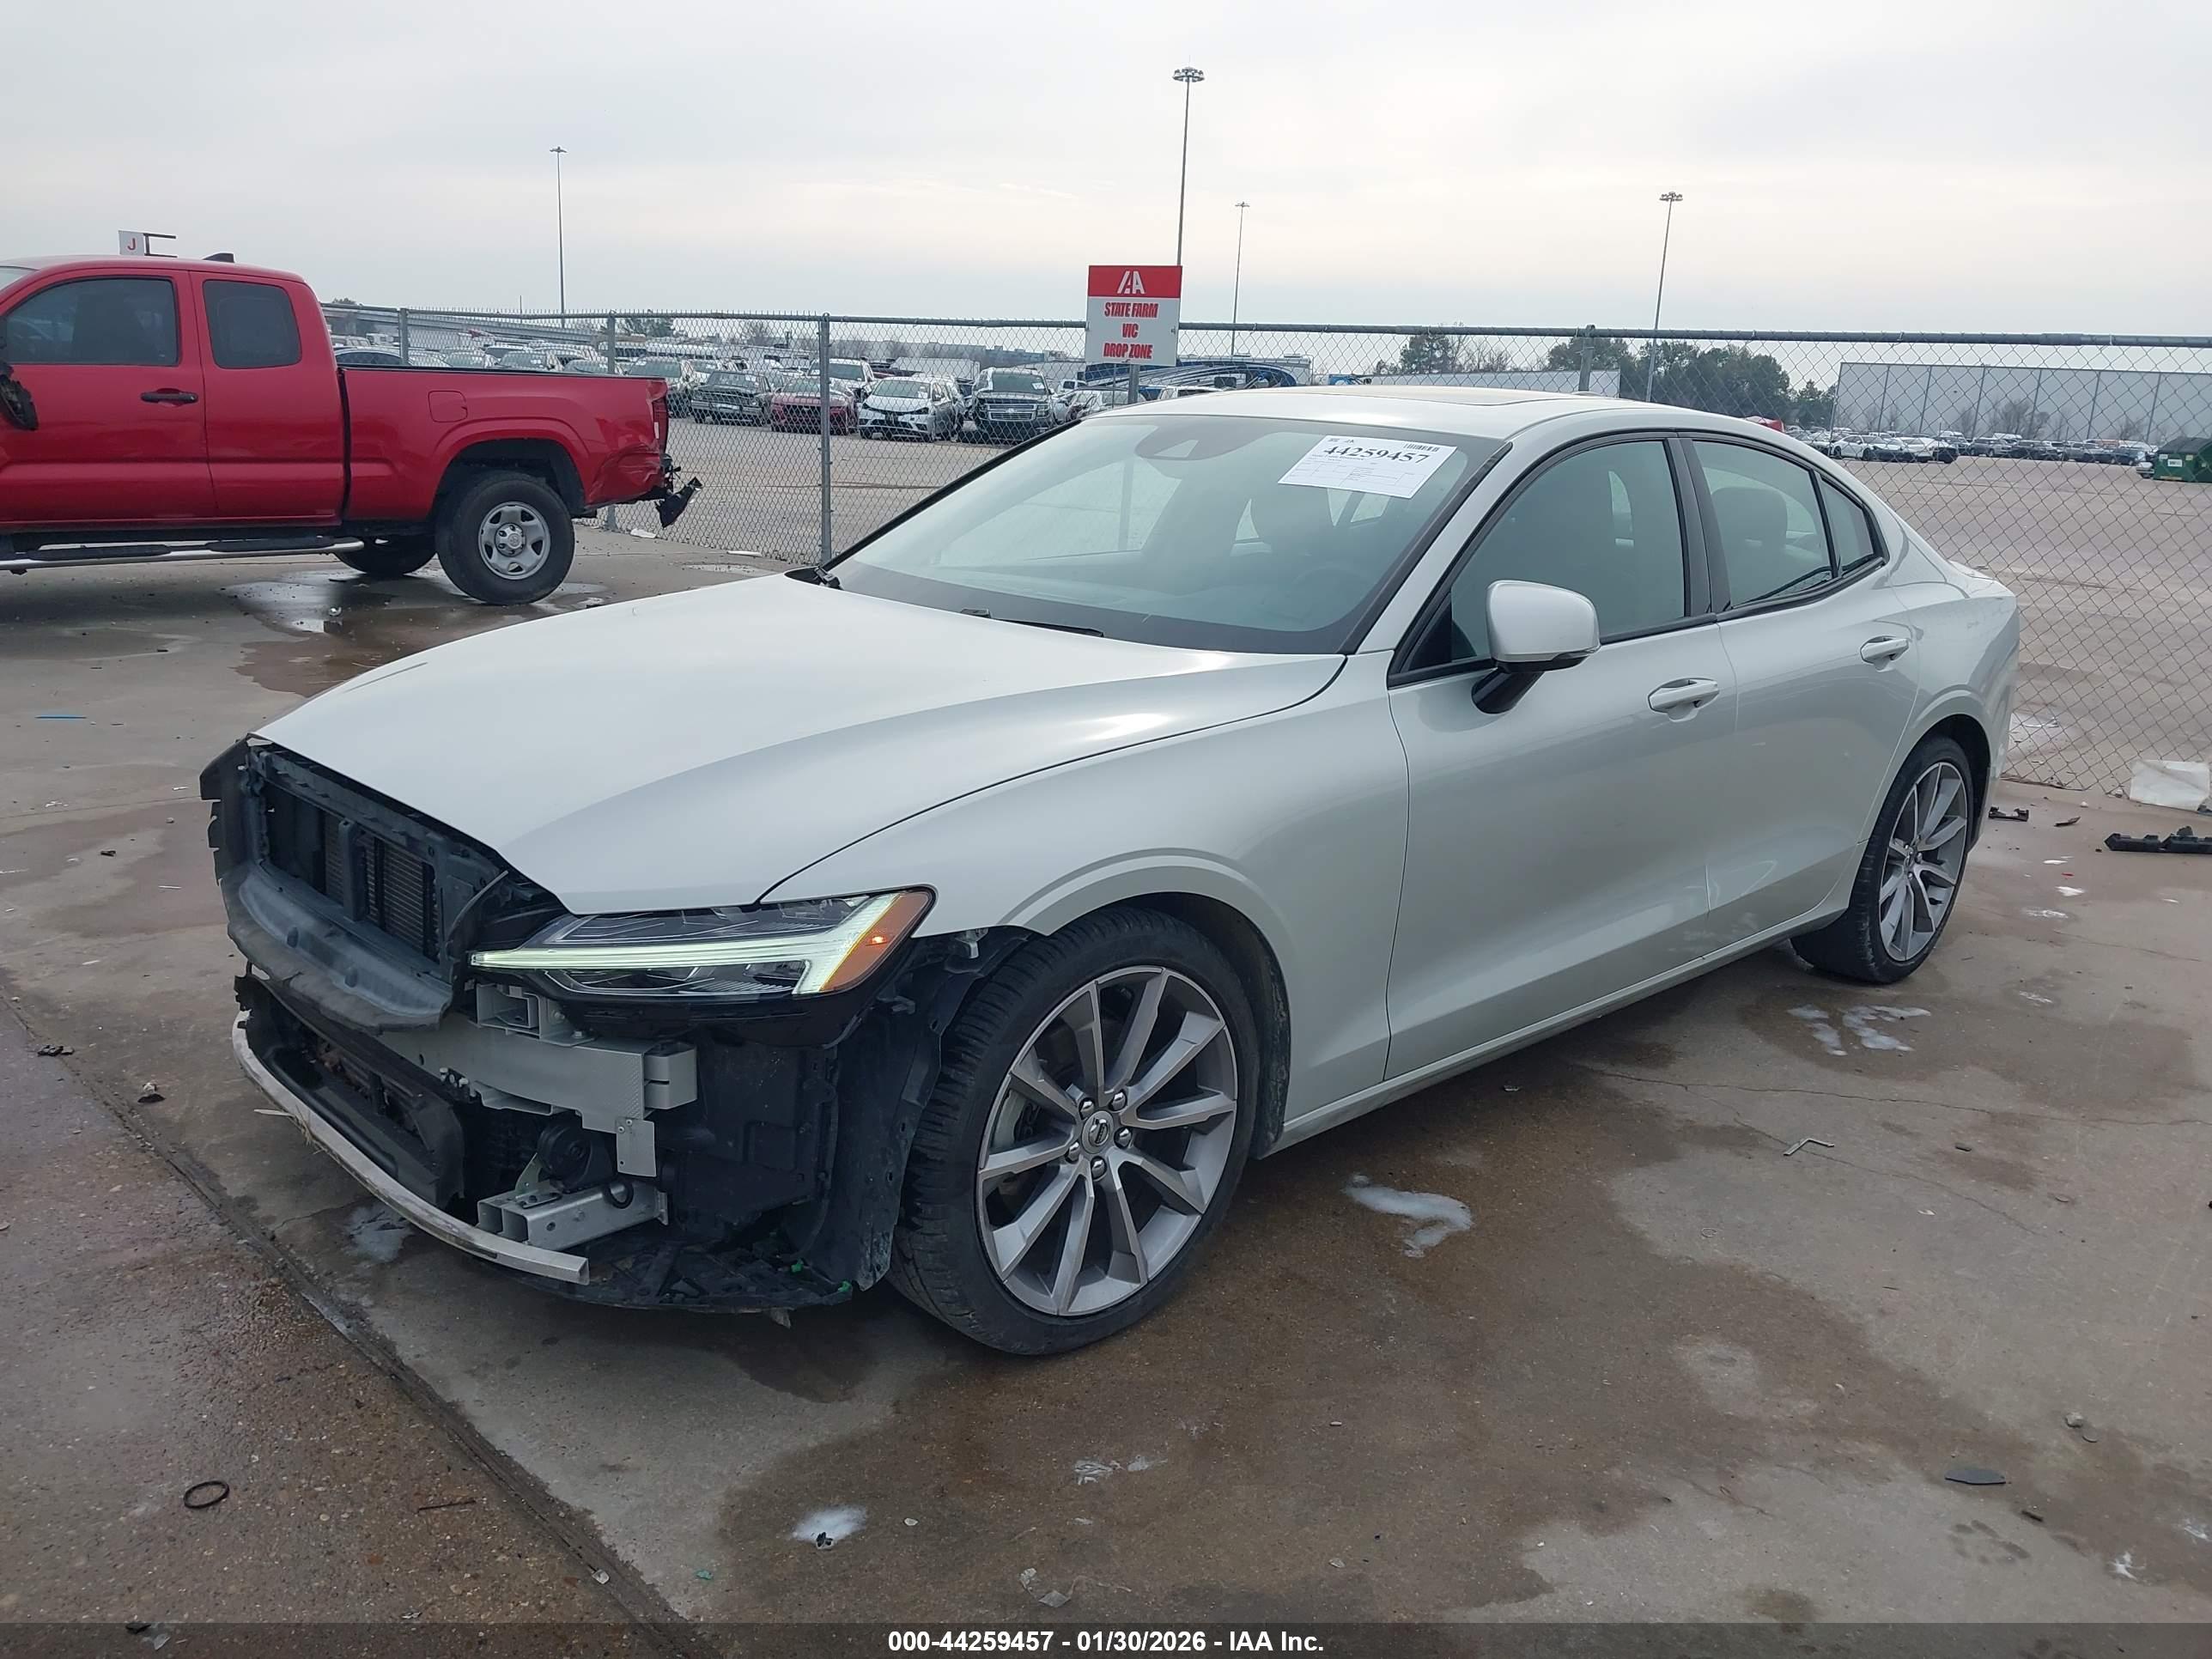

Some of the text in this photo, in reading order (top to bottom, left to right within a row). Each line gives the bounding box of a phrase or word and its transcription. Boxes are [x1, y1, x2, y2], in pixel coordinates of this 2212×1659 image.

[127, 238, 136, 251] J
[1104, 301, 1158, 319] STATE FARM
[1121, 323, 1139, 338] VIC
[1103, 343, 1153, 359] DROP ZONE
[1323, 446, 1430, 464] 44259457
